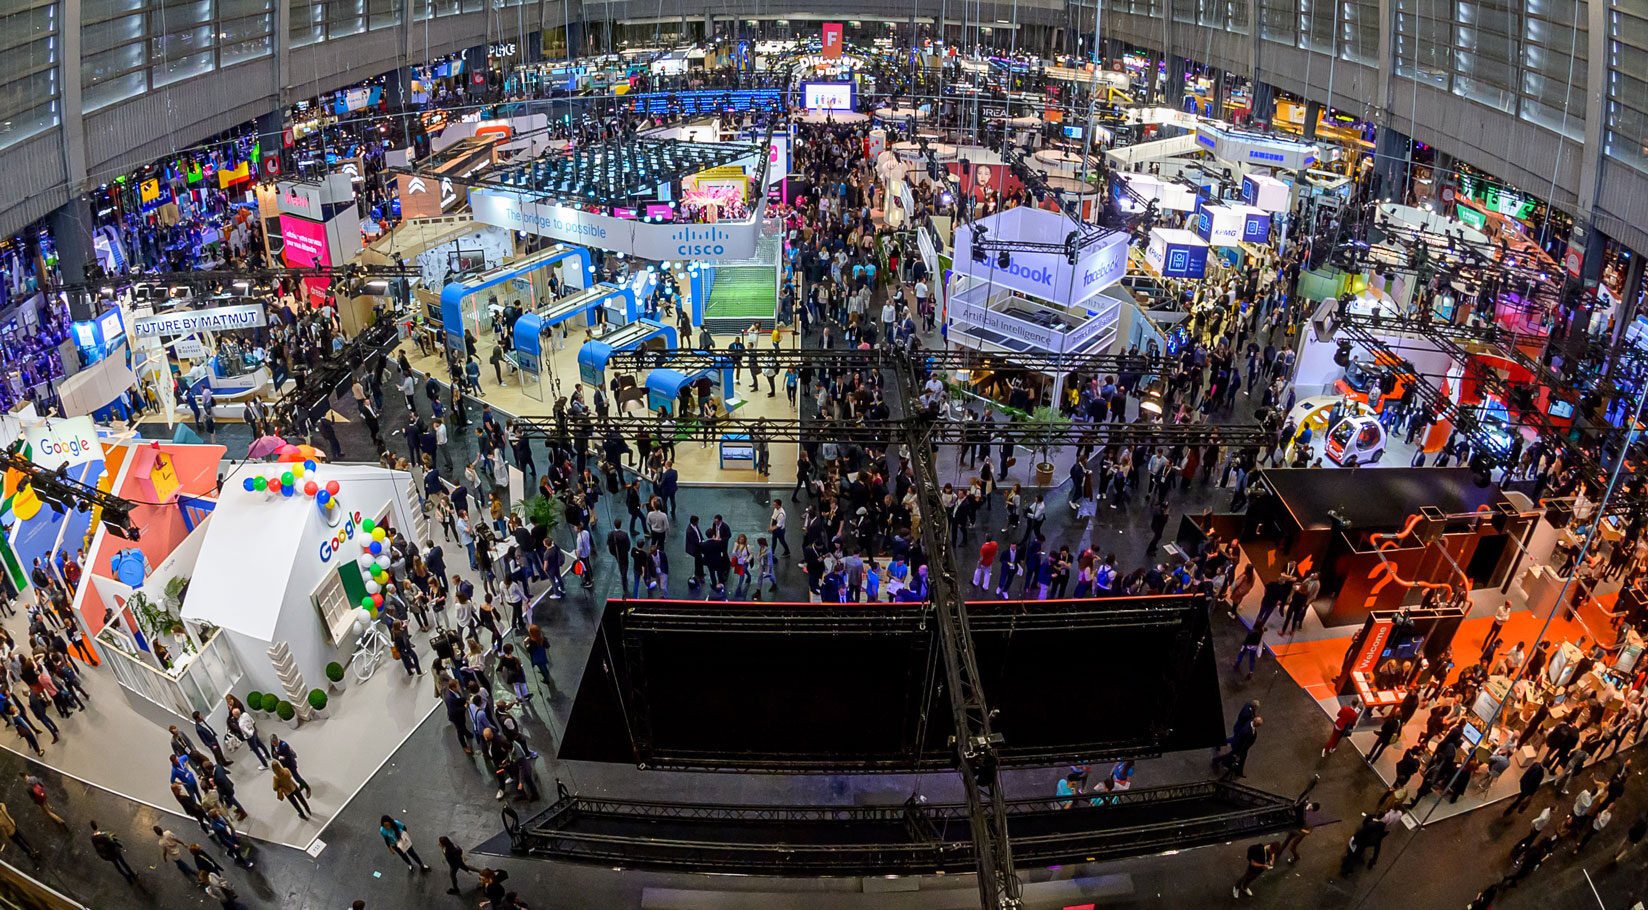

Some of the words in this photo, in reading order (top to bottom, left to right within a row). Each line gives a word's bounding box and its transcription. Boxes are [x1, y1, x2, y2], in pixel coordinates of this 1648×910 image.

[827, 31, 837, 47] F
[1249, 150, 1284, 161] SAMSUNG
[506, 208, 521, 220] The
[523, 213, 551, 229] bridge
[553, 218, 563, 229] to
[565, 222, 607, 239] possible
[678, 245, 724, 256] CISCO
[135, 321, 181, 335] FUTURE
[182, 317, 198, 329] BY
[200, 311, 257, 327] MATMUT
[963, 309, 1000, 328] Artificial
[1000, 320, 1052, 345] Intelligence
[40, 434, 90, 457] Google
[319, 511, 362, 563] Google
[1360, 626, 1387, 669] Welcome
